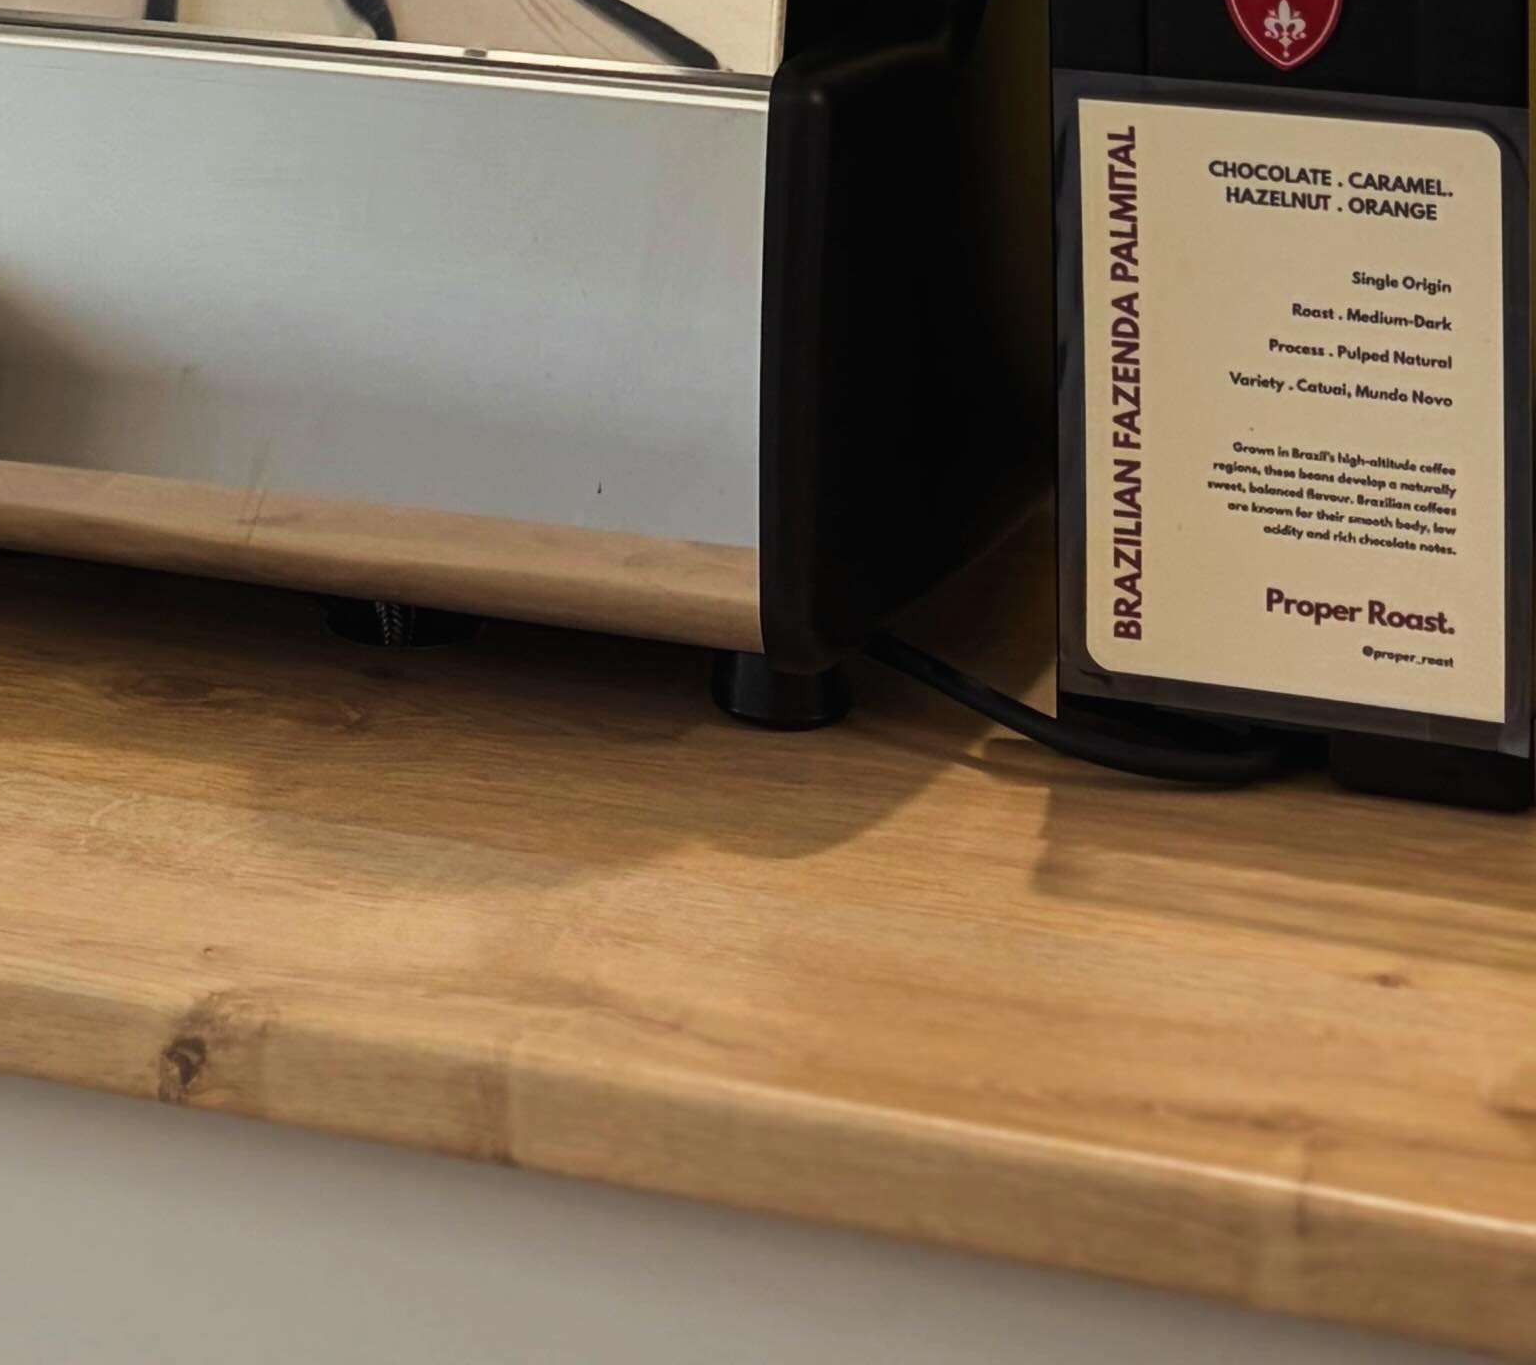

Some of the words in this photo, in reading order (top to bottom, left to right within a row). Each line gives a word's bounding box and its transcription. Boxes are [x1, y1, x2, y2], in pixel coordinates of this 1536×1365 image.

[1208, 160, 1332, 186] CHOCOLATE
[1348, 172, 1453, 197] CARAMEL.
[1107, 125, 1139, 283] PALMITAL
[1226, 186, 1332, 211] HAZELNUT
[1348, 197, 1438, 221] ORANGE
[1352, 271, 1398, 291] Single
[1402, 276, 1451, 295] Origin
[1292, 303, 1334, 320] Roast
[1347, 307, 1452, 331] Medium-Dark
[1112, 292, 1141, 449] FAZENDA
[1269, 338, 1325, 357] Process
[1337, 345, 1389, 364] Pulped
[1393, 351, 1452, 369] Natural
[1229, 371, 1285, 393] Variety
[1296, 378, 1352, 398] Catuai,
[1355, 384, 1408, 403] Mundo
[1412, 390, 1453, 407] Novo
[1233, 441, 1275, 456] Grown
[1278, 446, 1289, 457] in
[1292, 448, 1335, 463] Brazil's
[1338, 452, 1417, 471] high-altitude
[1420, 462, 1456, 476] coffee
[1213, 461, 1261, 475] regions,
[1264, 465, 1295, 478] these
[1299, 468, 1334, 482] beans
[1338, 473, 1386, 491] develop
[1389, 481, 1397, 489] a
[1400, 482, 1456, 499] naturally
[1208, 480, 1246, 493] sweet,
[1249, 482, 1303, 498] balanced
[1307, 488, 1354, 504] flavour.
[1357, 494, 1411, 510] Brazilian
[1414, 502, 1456, 516] coffees
[1228, 502, 1248, 512] are
[1251, 502, 1293, 516] known
[1296, 506, 1313, 518] for
[1317, 510, 1345, 522] their
[1348, 516, 1393, 528] smooth
[1433, 522, 1456, 535] low
[1113, 459, 1142, 641] BRAZILIAN
[1264, 524, 1303, 540] acidity
[1306, 529, 1330, 540] and
[1333, 531, 1356, 543] rich
[1359, 534, 1416, 550] chocolate
[1420, 543, 1456, 555] notes.
[1266, 587, 1362, 625] Proper
[1368, 600, 1455, 635] Roast.
[1362, 645, 1454, 668] @proper_roast
